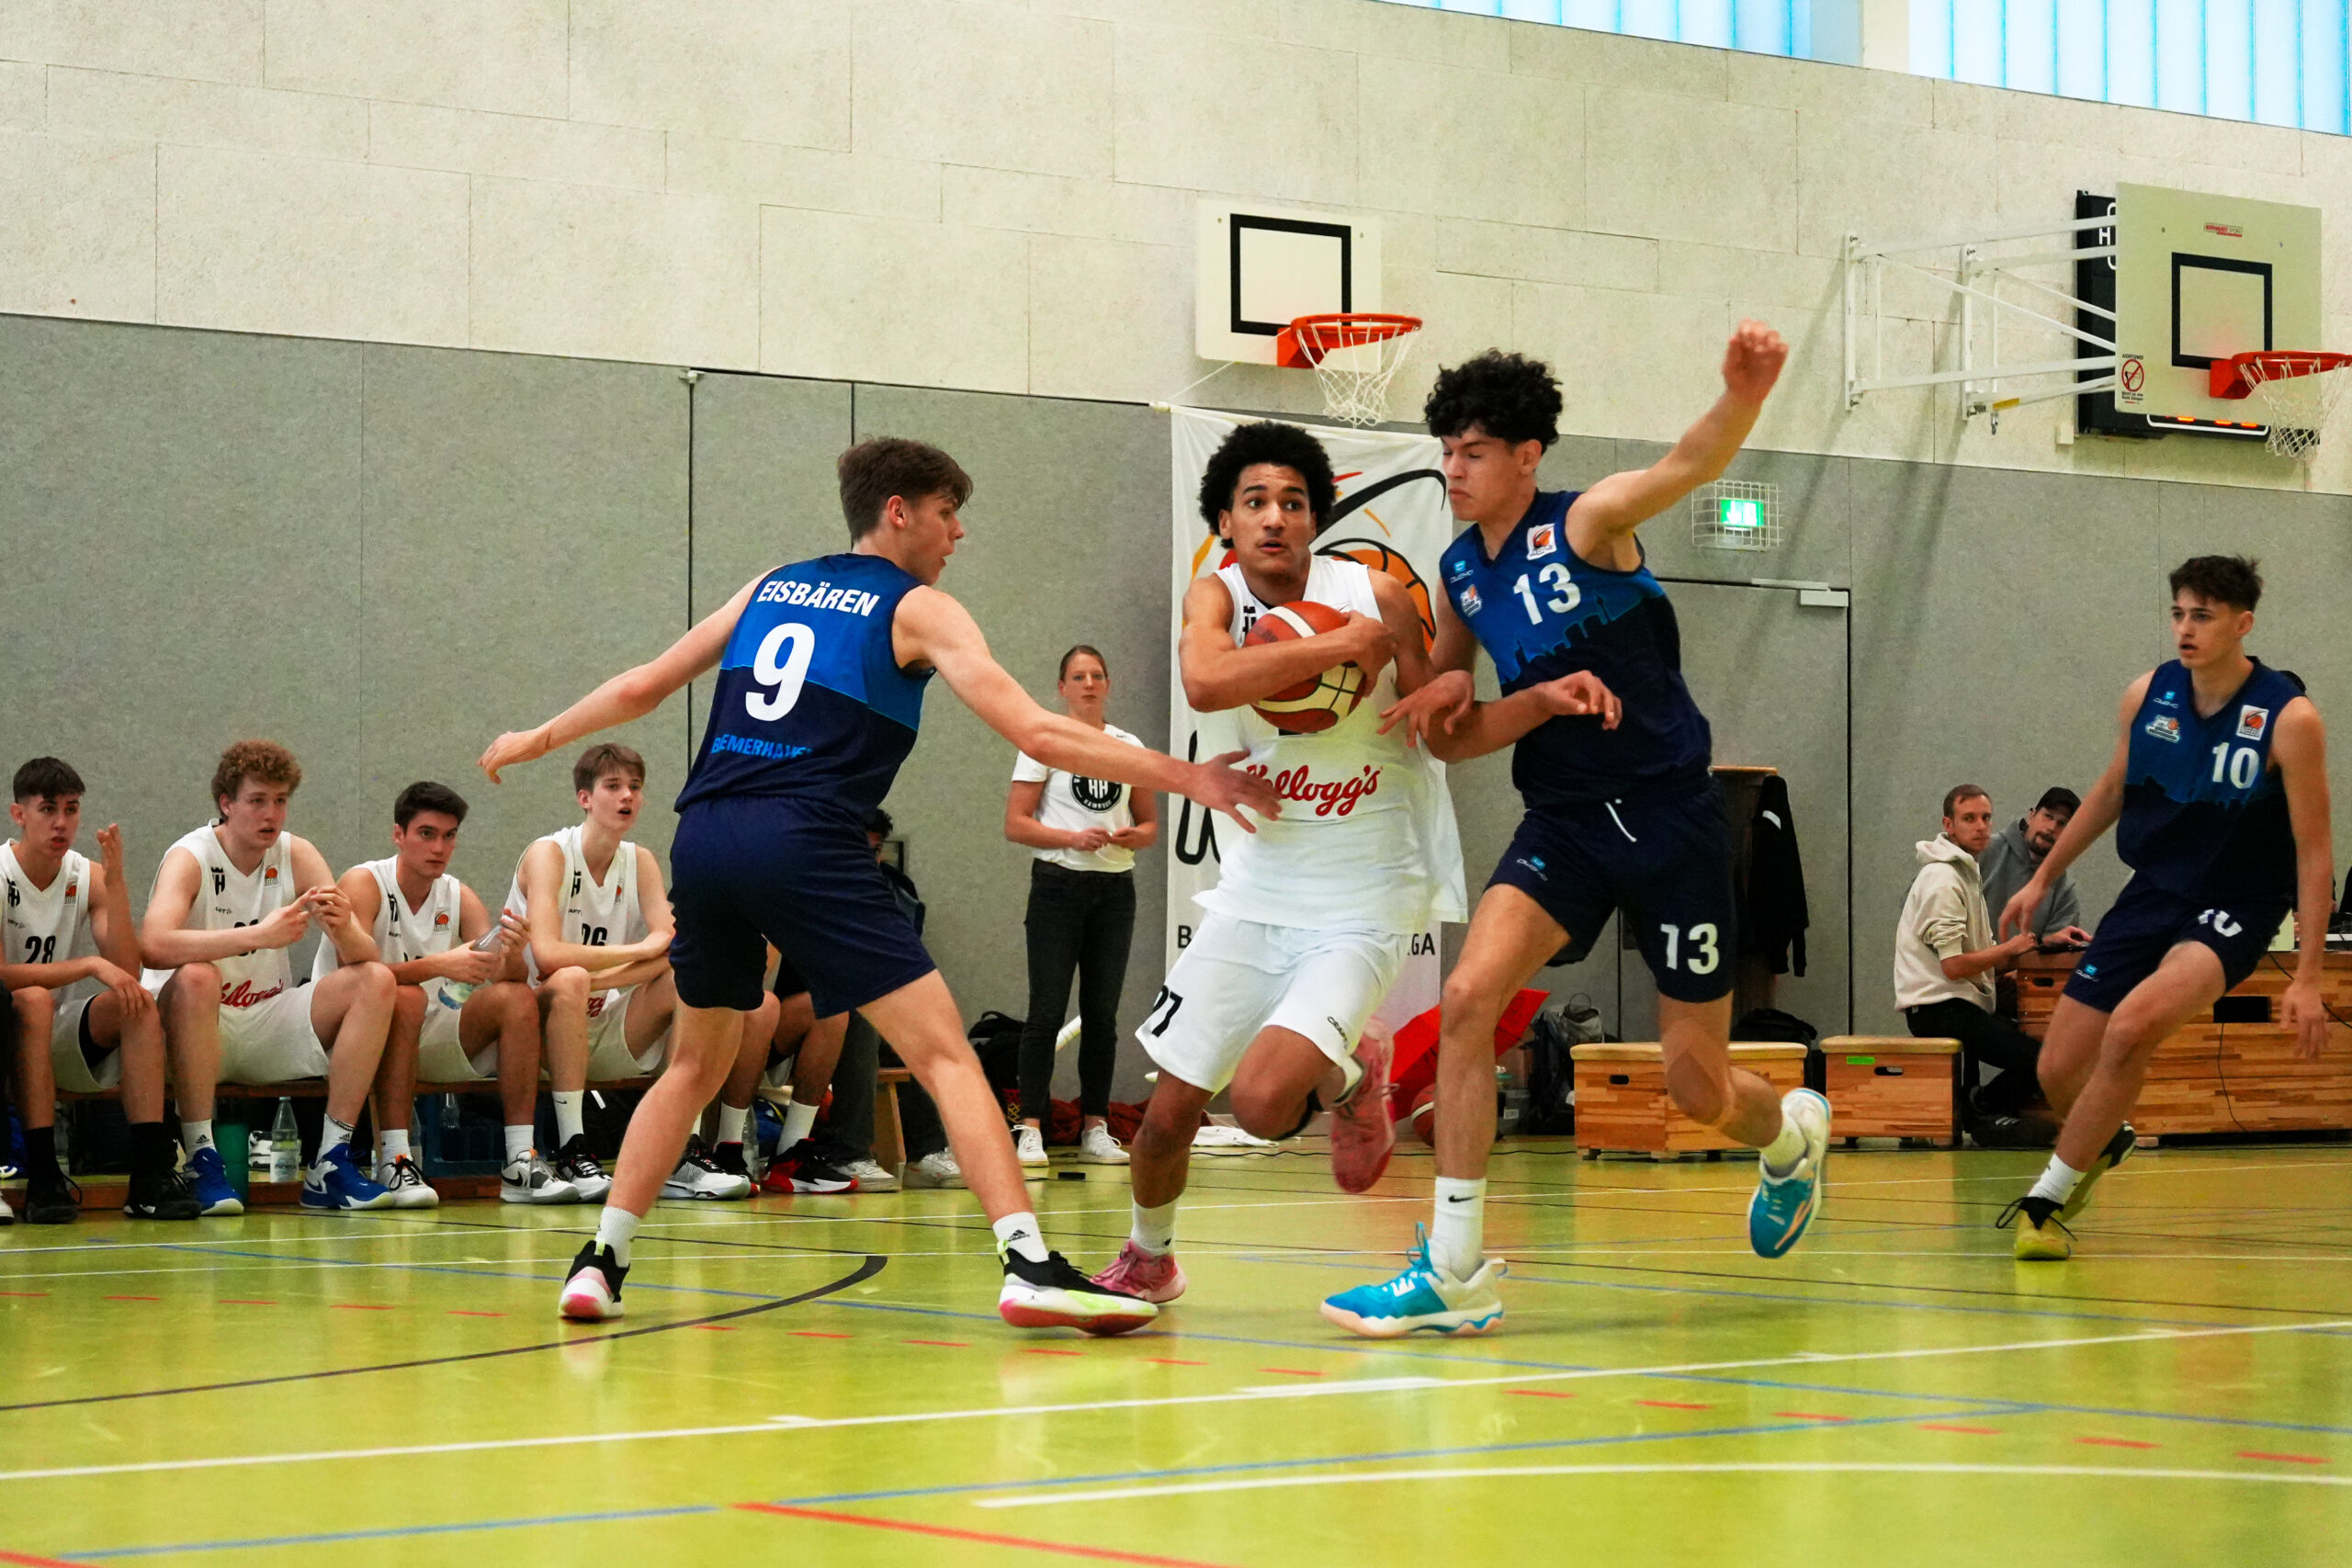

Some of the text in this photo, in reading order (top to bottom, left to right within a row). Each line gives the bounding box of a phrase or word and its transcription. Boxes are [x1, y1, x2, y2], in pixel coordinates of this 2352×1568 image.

[756, 580, 880, 617] EISBÄREN
[1512, 562, 1581, 626] 13
[745, 622, 816, 722] 9
[1247, 764, 1381, 817] llogg's
[2211, 741, 2260, 790] 10
[1177, 925, 1436, 956] B GA
[1660, 922, 1721, 976] 13
